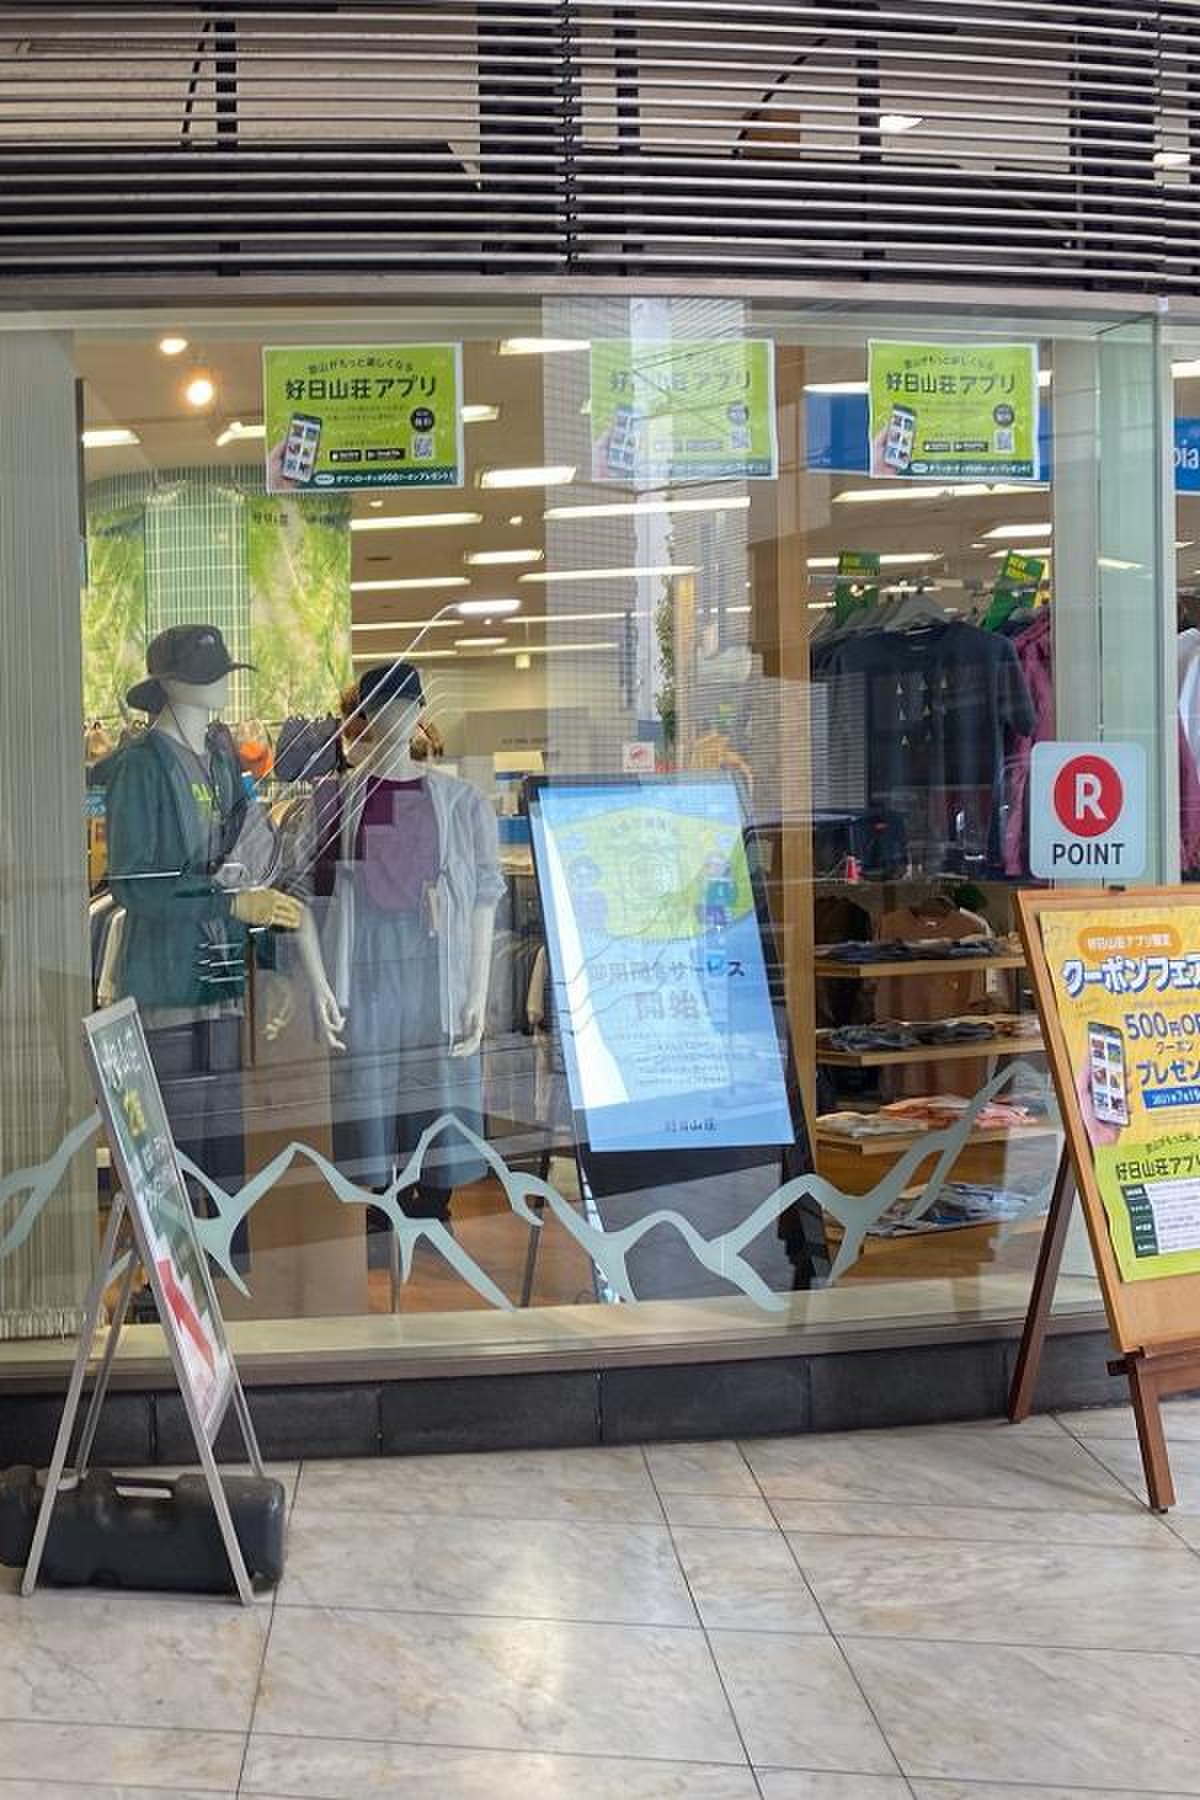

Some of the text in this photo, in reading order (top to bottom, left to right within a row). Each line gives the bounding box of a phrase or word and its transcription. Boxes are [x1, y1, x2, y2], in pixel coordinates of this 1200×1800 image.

[285, 375, 436, 400] 好日山荘アプリ
[886, 372, 1015, 395] 好日山荘アプリ
[1051, 842, 1125, 866] POINT
